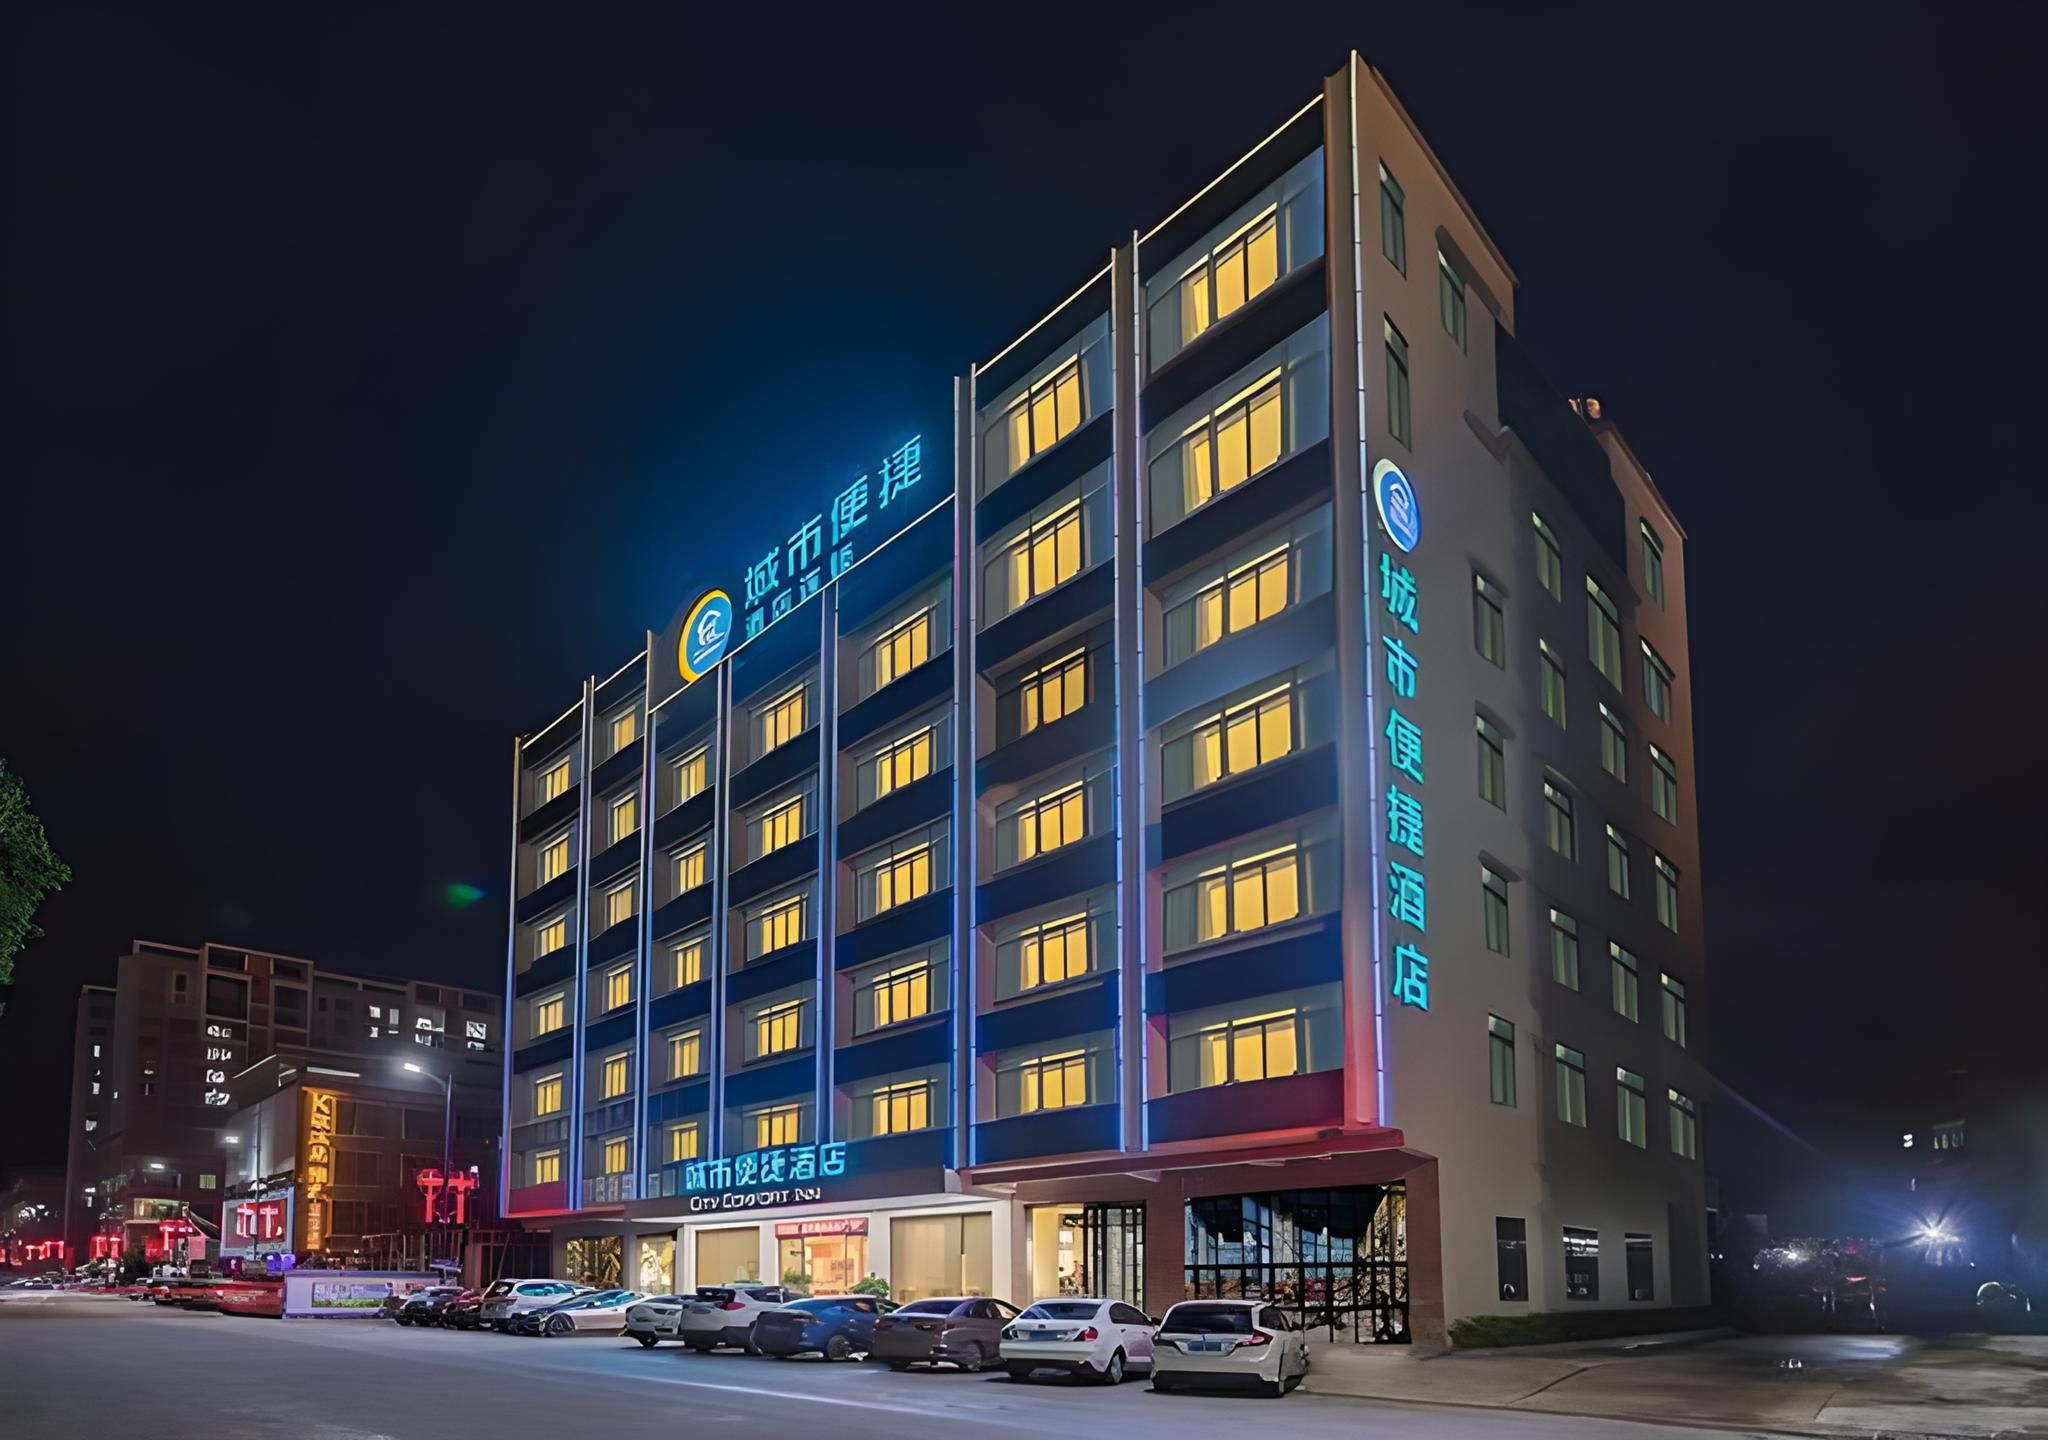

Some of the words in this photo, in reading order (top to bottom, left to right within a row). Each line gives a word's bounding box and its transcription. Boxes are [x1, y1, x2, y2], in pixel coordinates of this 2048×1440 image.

[744, 434, 922, 609] 城市便捷
[1379, 552, 1430, 1011] 城市便捷酒店
